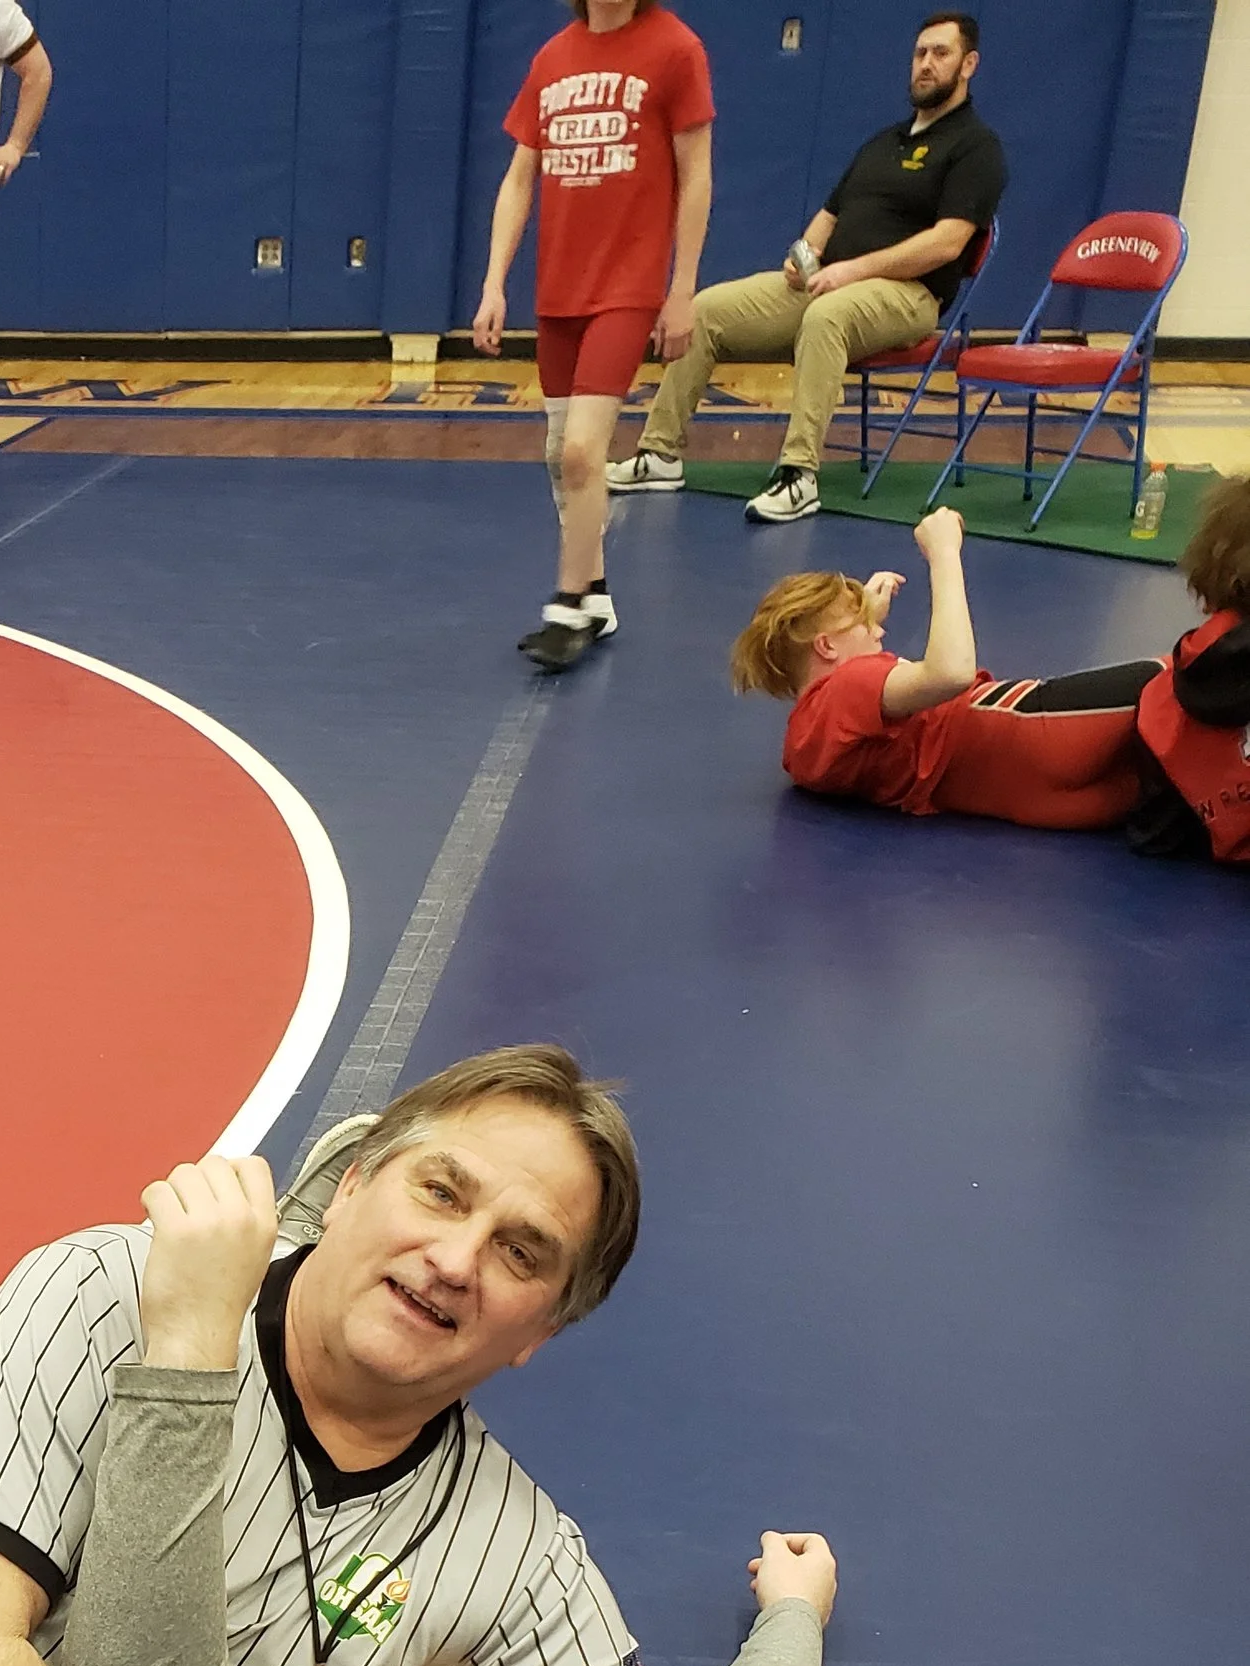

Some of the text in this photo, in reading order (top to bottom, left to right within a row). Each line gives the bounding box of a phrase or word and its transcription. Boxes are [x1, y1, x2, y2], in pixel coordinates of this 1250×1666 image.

[539, 72, 649, 120] PROPERTY OF
[555, 117, 622, 141] TRIAD
[542, 144, 638, 176] WRESTLING
[1077, 236, 1161, 264] GREENEVIEW
